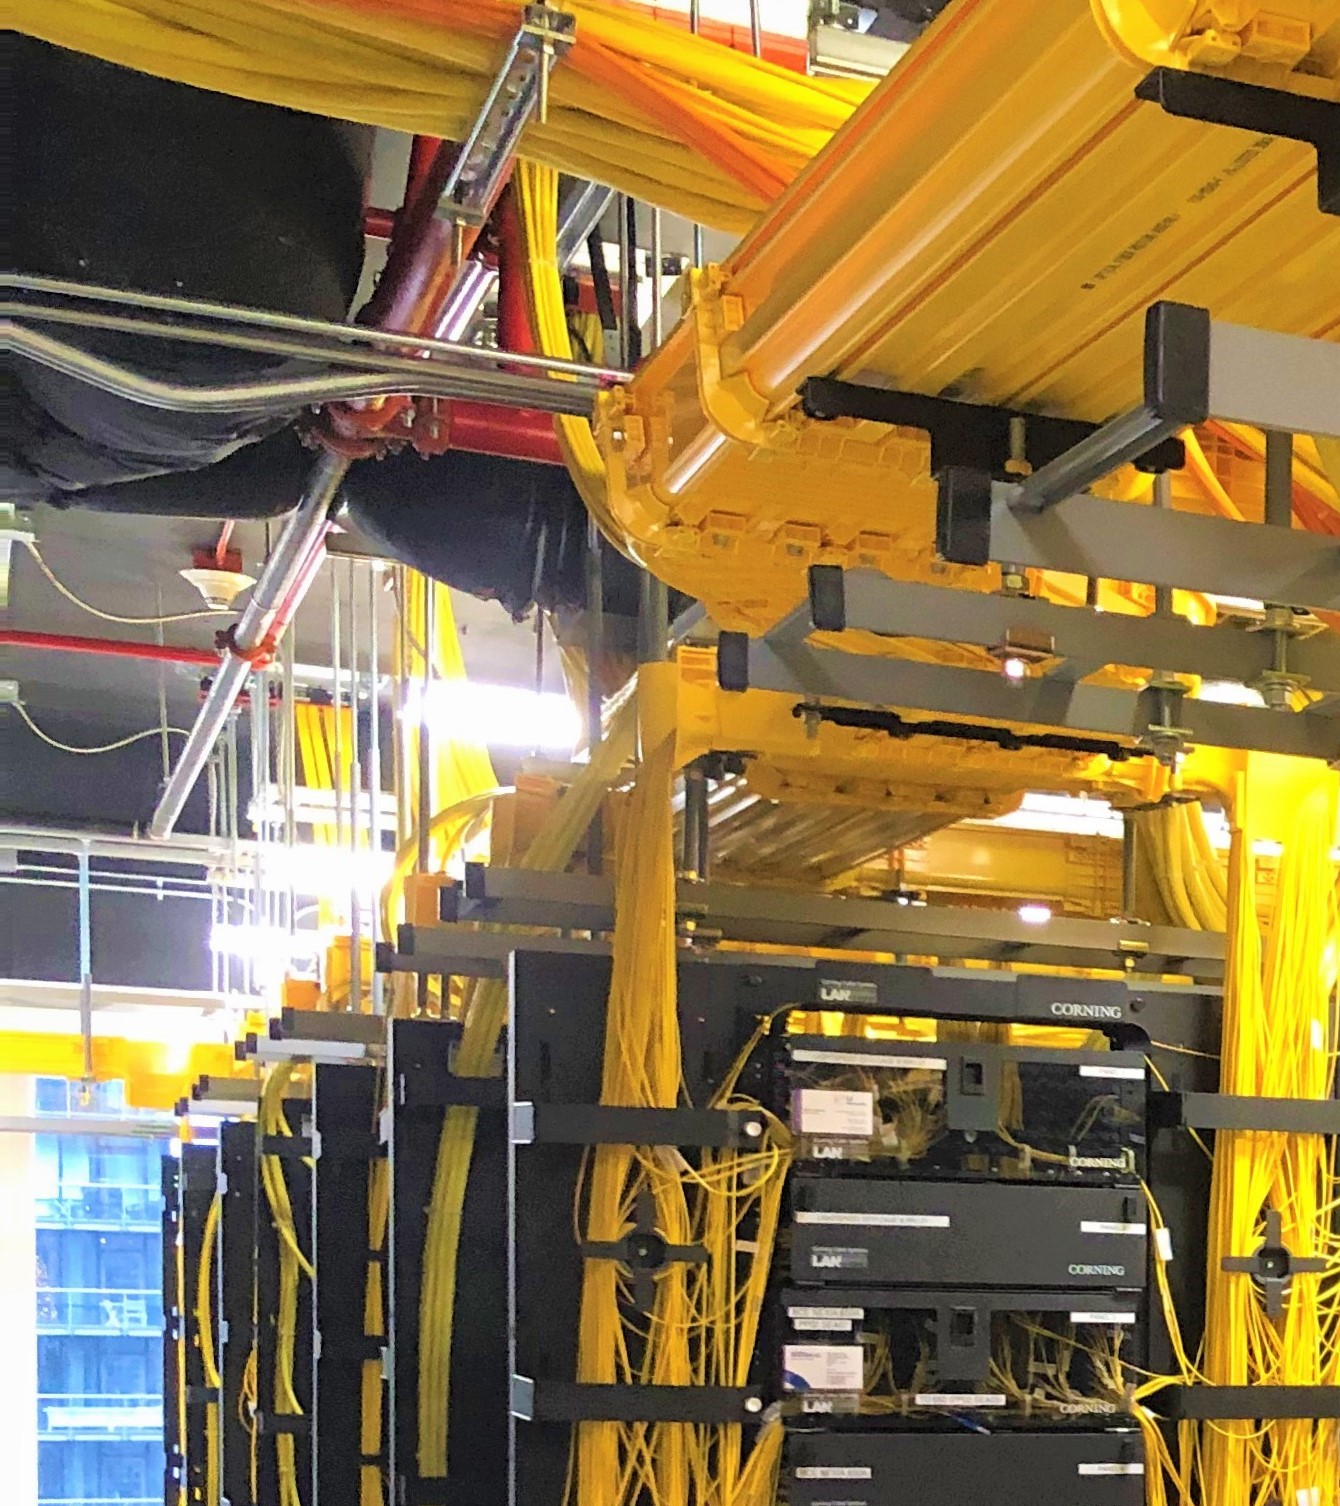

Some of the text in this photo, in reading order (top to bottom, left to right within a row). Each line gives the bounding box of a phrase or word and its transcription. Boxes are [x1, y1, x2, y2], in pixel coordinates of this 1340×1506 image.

[1051, 1002, 1122, 1019] CORNING
[1069, 1156, 1126, 1169] CORNING
[1068, 1263, 1125, 1276] CORNING
[1059, 1402, 1116, 1414] CORNING
